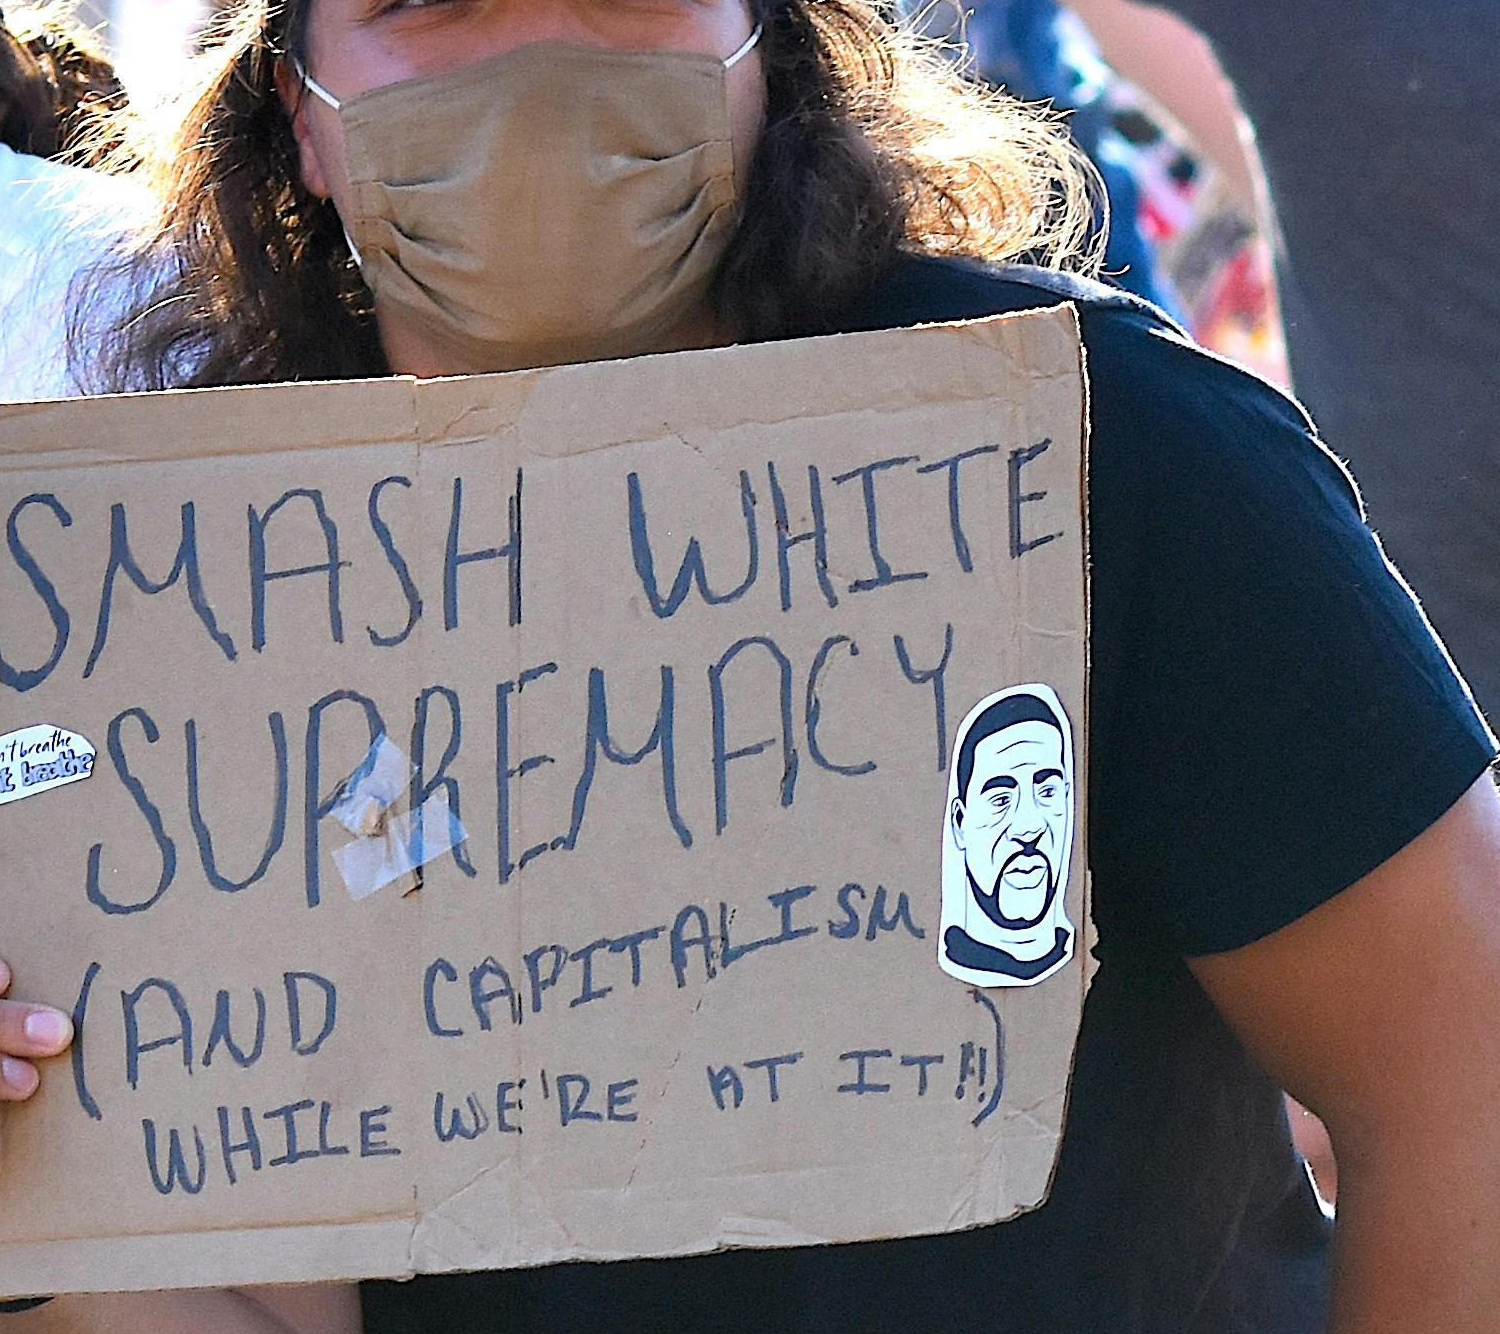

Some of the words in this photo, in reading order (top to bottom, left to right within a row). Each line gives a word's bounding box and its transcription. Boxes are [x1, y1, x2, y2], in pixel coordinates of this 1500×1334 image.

[628, 438, 1066, 619] WHITE
[19, 729, 72, 758] breathe
[85, 623, 956, 917] SUPREMACY
[70, 962, 338, 1120] (AND
[423, 881, 928, 1038] CAPITALISM
[142, 1097, 403, 1195] WHILE
[433, 1065, 641, 1140] WE'RE
[707, 1052, 805, 1112] AT
